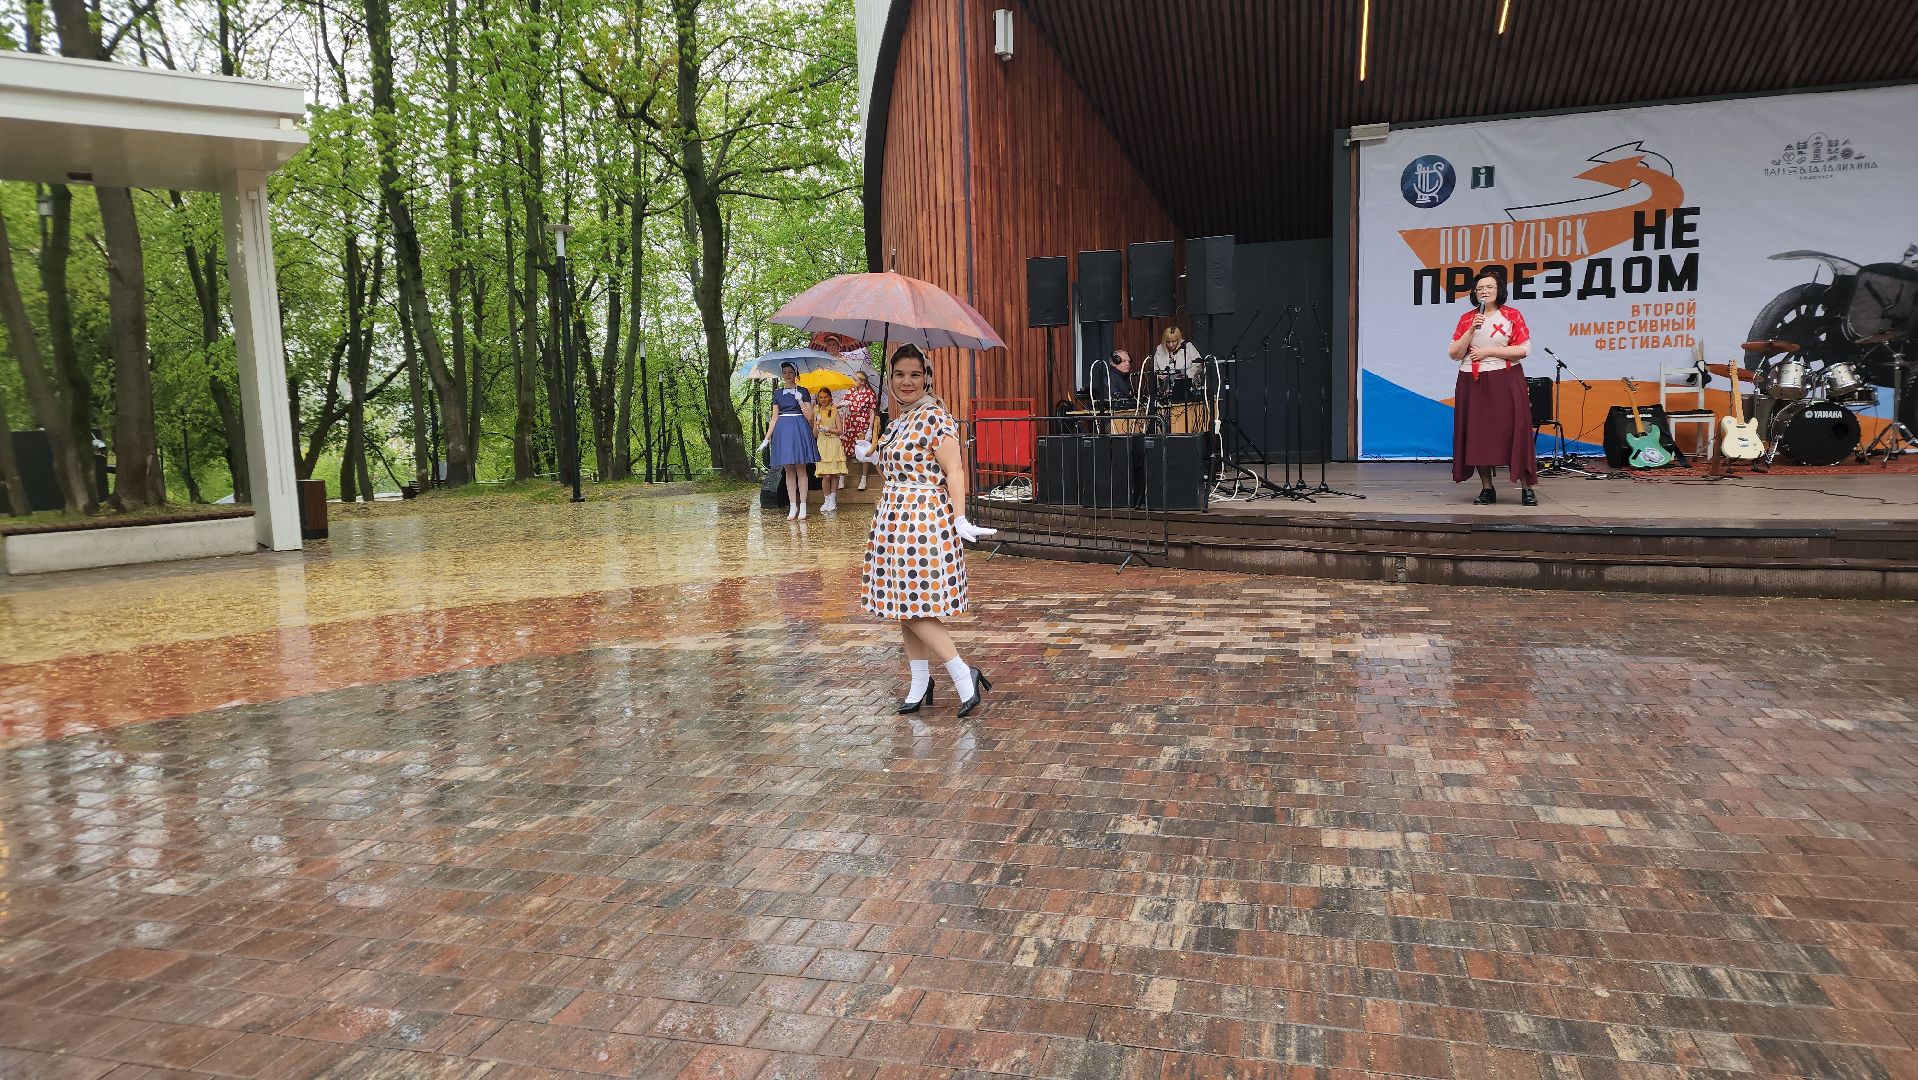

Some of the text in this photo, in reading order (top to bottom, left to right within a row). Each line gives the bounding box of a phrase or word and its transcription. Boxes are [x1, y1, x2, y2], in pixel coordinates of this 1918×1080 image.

[1632, 206, 1700, 252] НЕ
[1439, 218, 1589, 265] ПОДОЛЬСК
[1413, 253, 1699, 306] ПРЕЗДОМ
[1631, 298, 1697, 318] ВТОРОЙ
[1568, 314, 1696, 337] ИММЕРСИВНЫЙ
[1595, 334, 1697, 351] ФЕСТИВАЛЬ
[1814, 410, 1843, 419] YAMAHA
